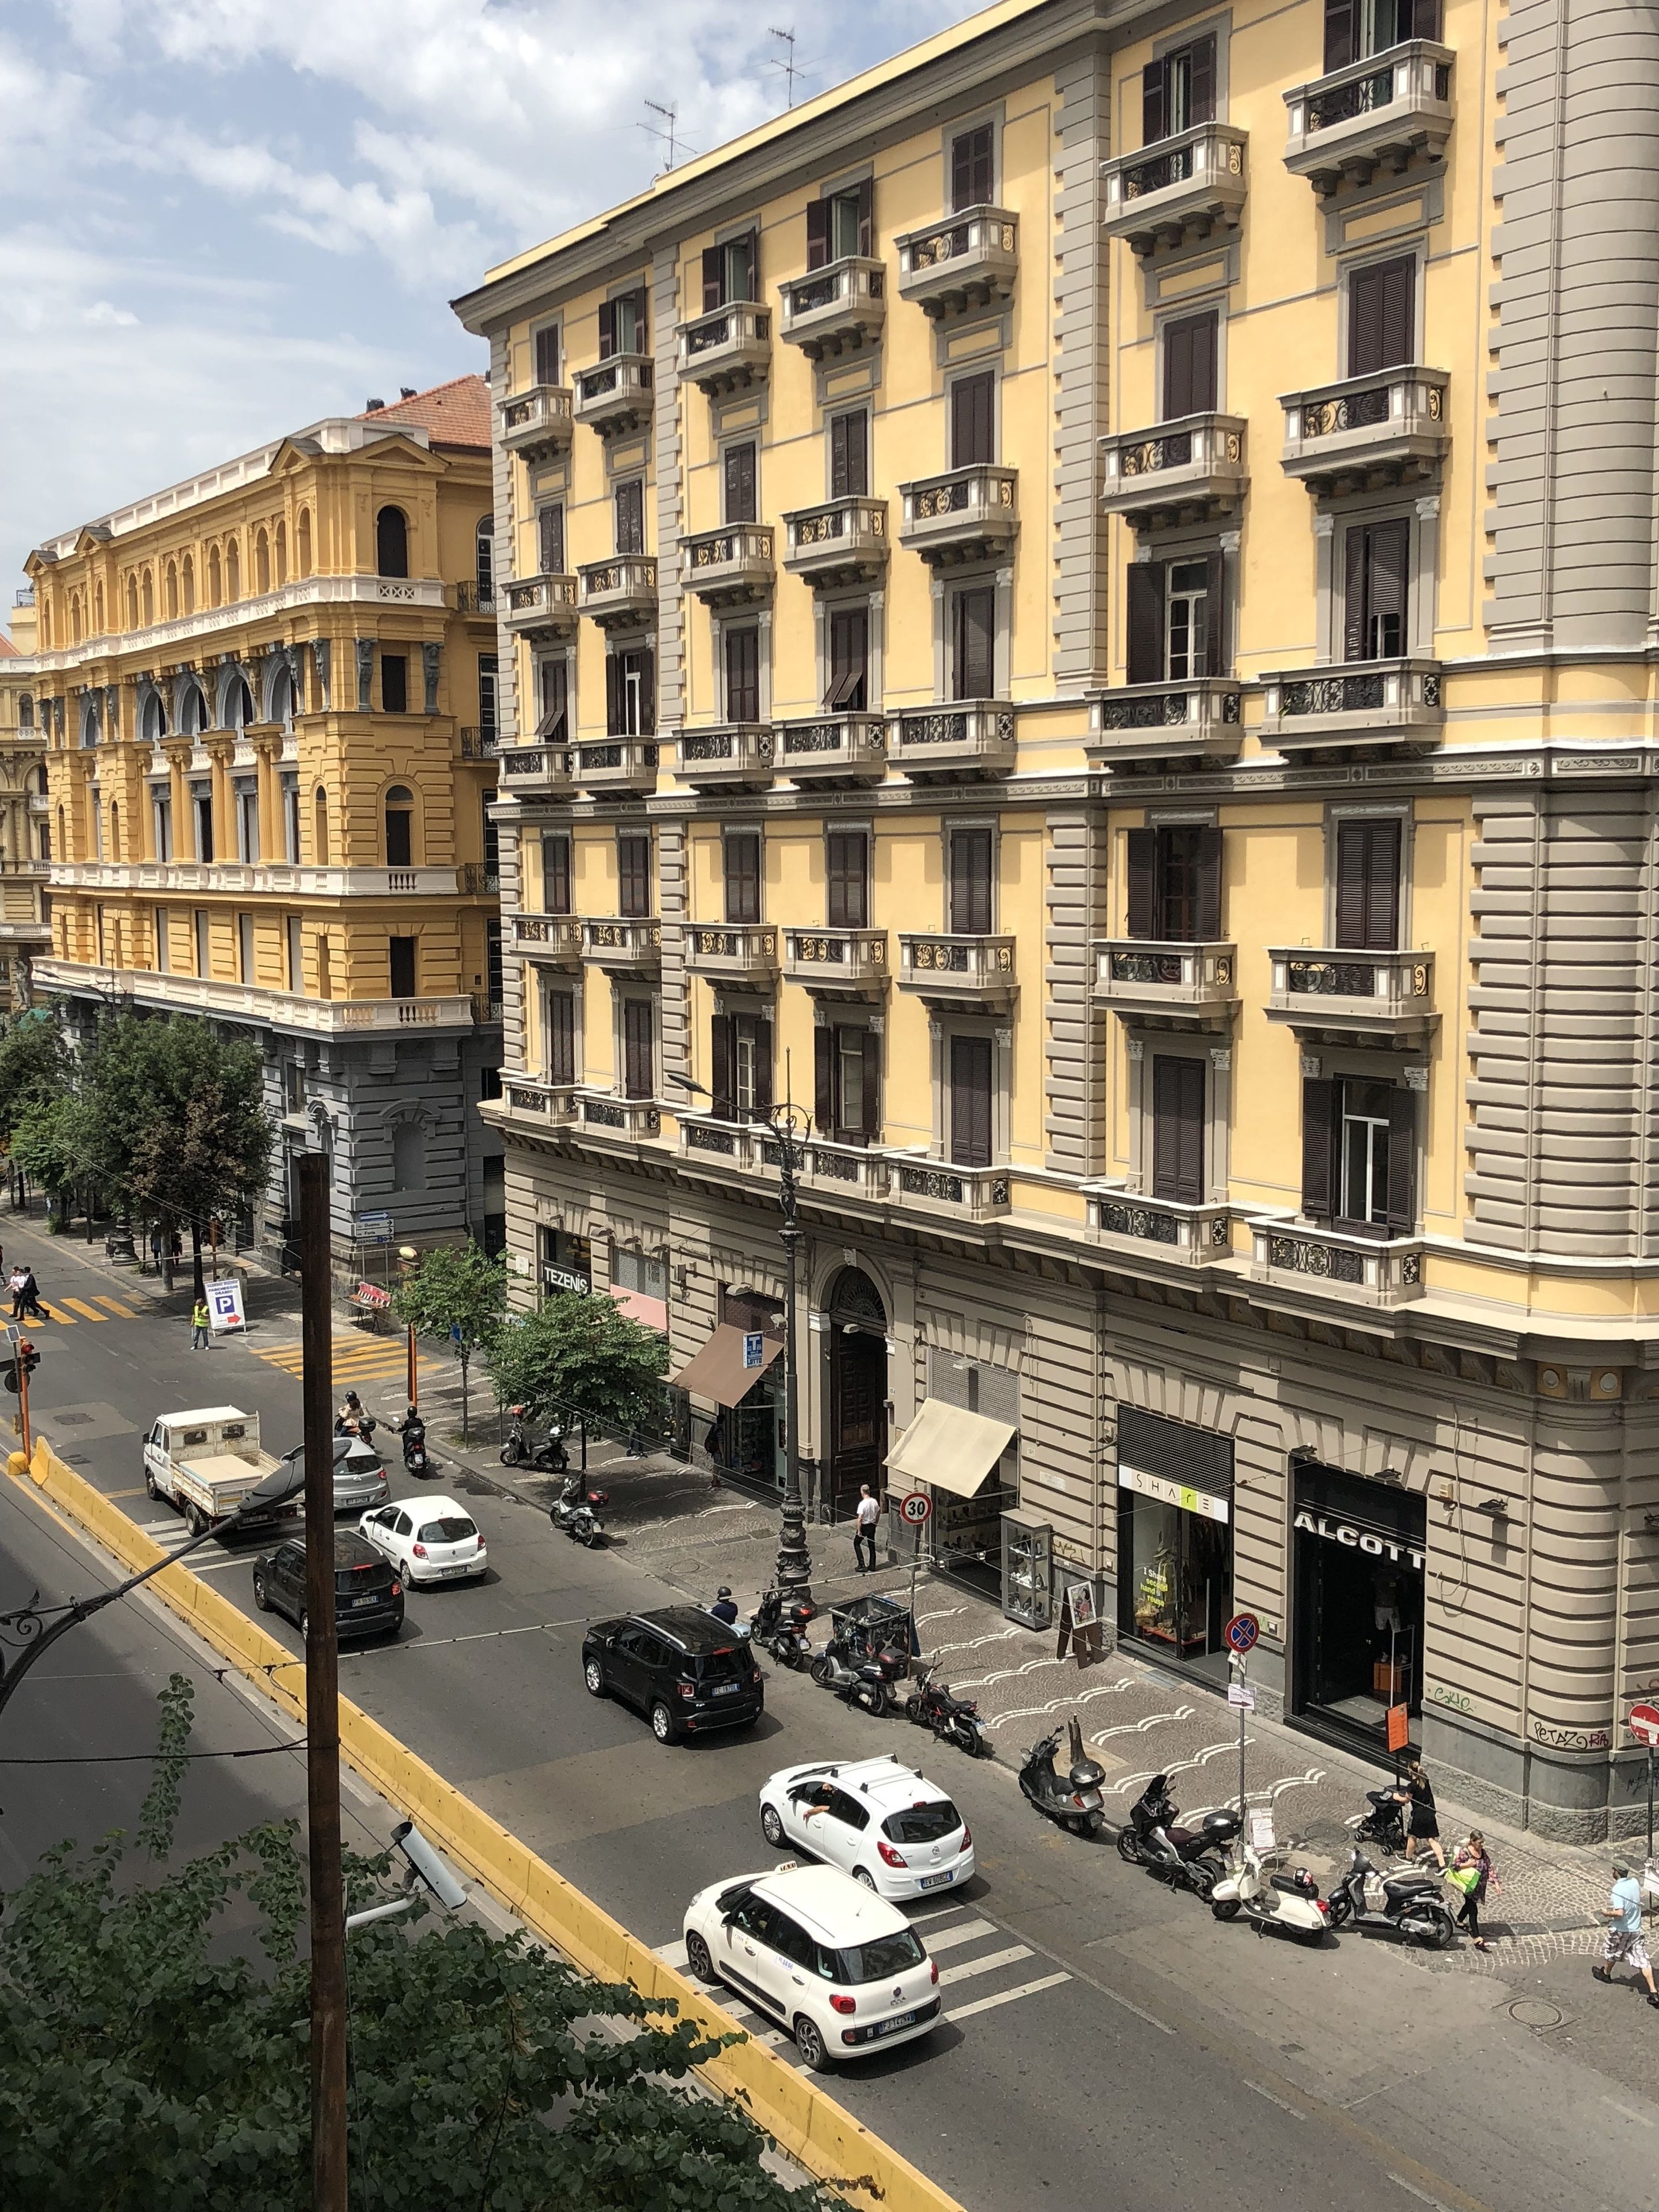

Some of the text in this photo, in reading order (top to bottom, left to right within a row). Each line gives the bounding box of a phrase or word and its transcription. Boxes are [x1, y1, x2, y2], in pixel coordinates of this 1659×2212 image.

[219, 1297, 232, 1313] P
[749, 1336, 760, 1351] T
[908, 1501, 925, 1516] 30
[1294, 1512, 1426, 1569] ALCOTT
[1143, 1567, 1166, 1582] I Share
[1140, 1582, 1156, 1595] hand
